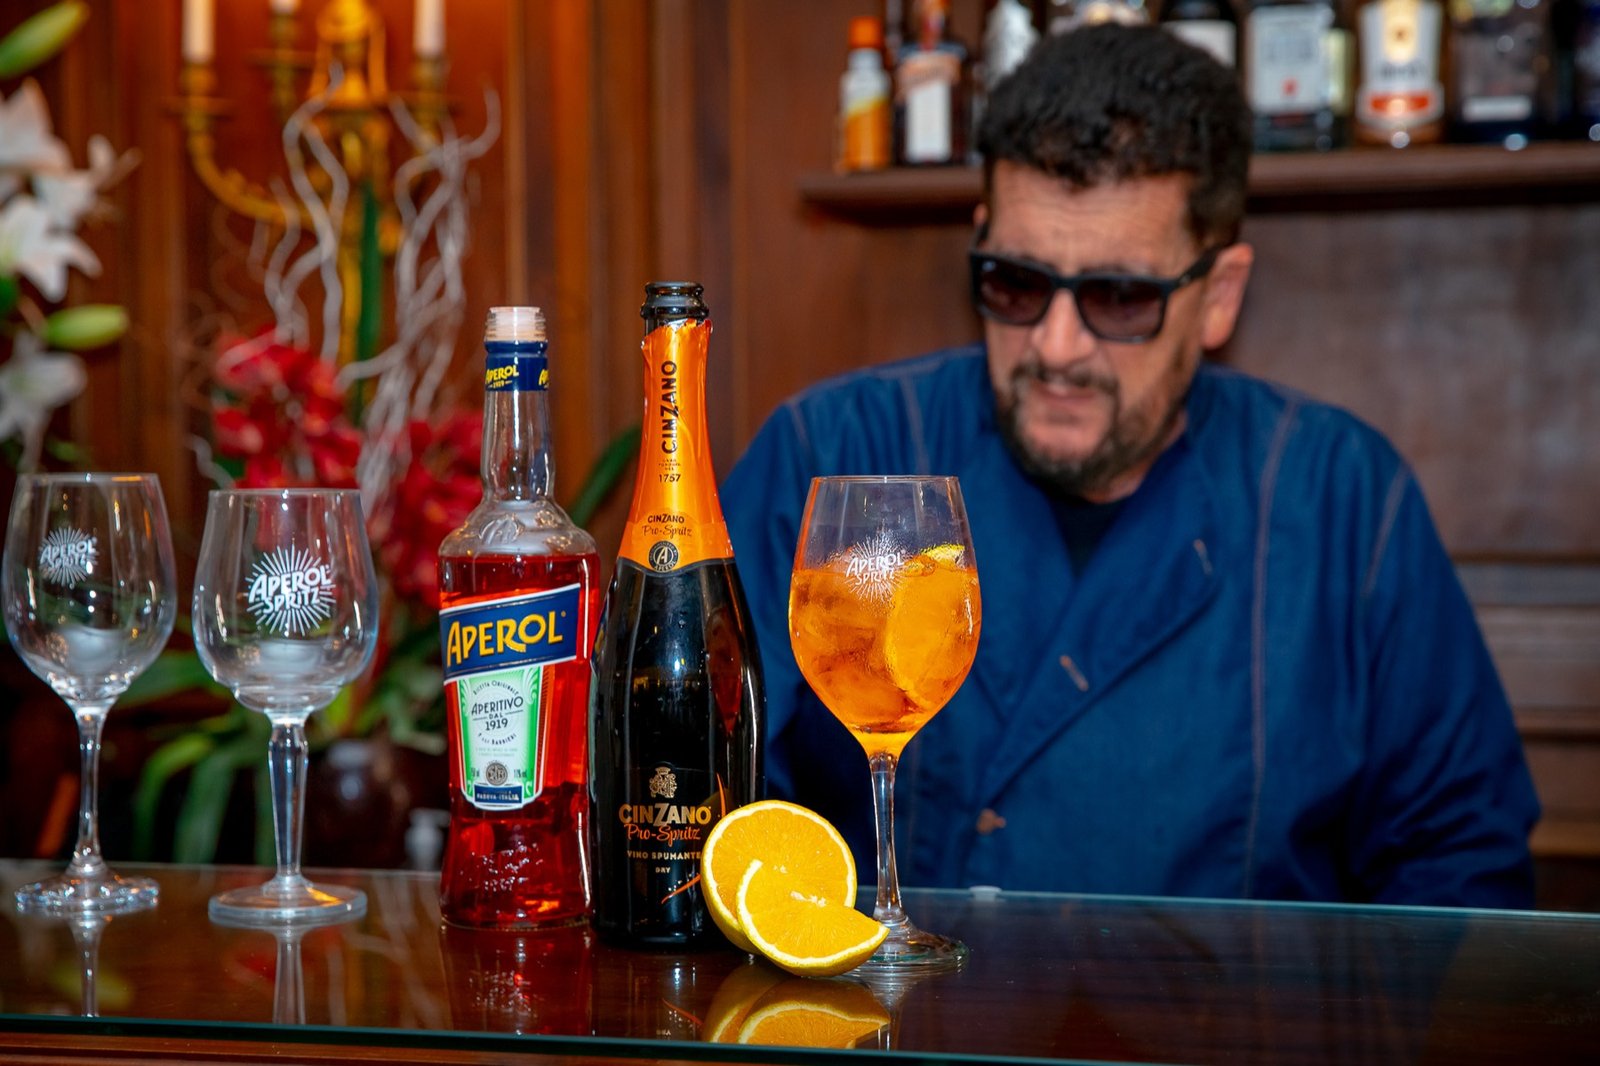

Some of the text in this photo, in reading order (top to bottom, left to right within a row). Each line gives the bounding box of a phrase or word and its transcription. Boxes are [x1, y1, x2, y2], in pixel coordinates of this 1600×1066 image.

[485, 364, 520, 385] APEROL
[660, 360, 679, 455] CINZANO
[659, 473, 681, 482] 1757
[647, 513, 685, 524] CINZANO
[641, 525, 693, 540] Pro-Spritz
[40, 539, 96, 565] APEROL
[846, 552, 905, 578] APEROL
[248, 564, 333, 604] APEROL
[855, 567, 895, 586] SPRITZ
[263, 586, 320, 614] SPRITZ
[447, 611, 563, 668] APEROL
[471, 696, 524, 716] APERITIVO
[485, 718, 508, 731] 1919
[618, 803, 711, 827] CINZANO
[623, 823, 701, 847] Pro-Spritz
[627, 850, 701, 860] VINO SPUMANTE
